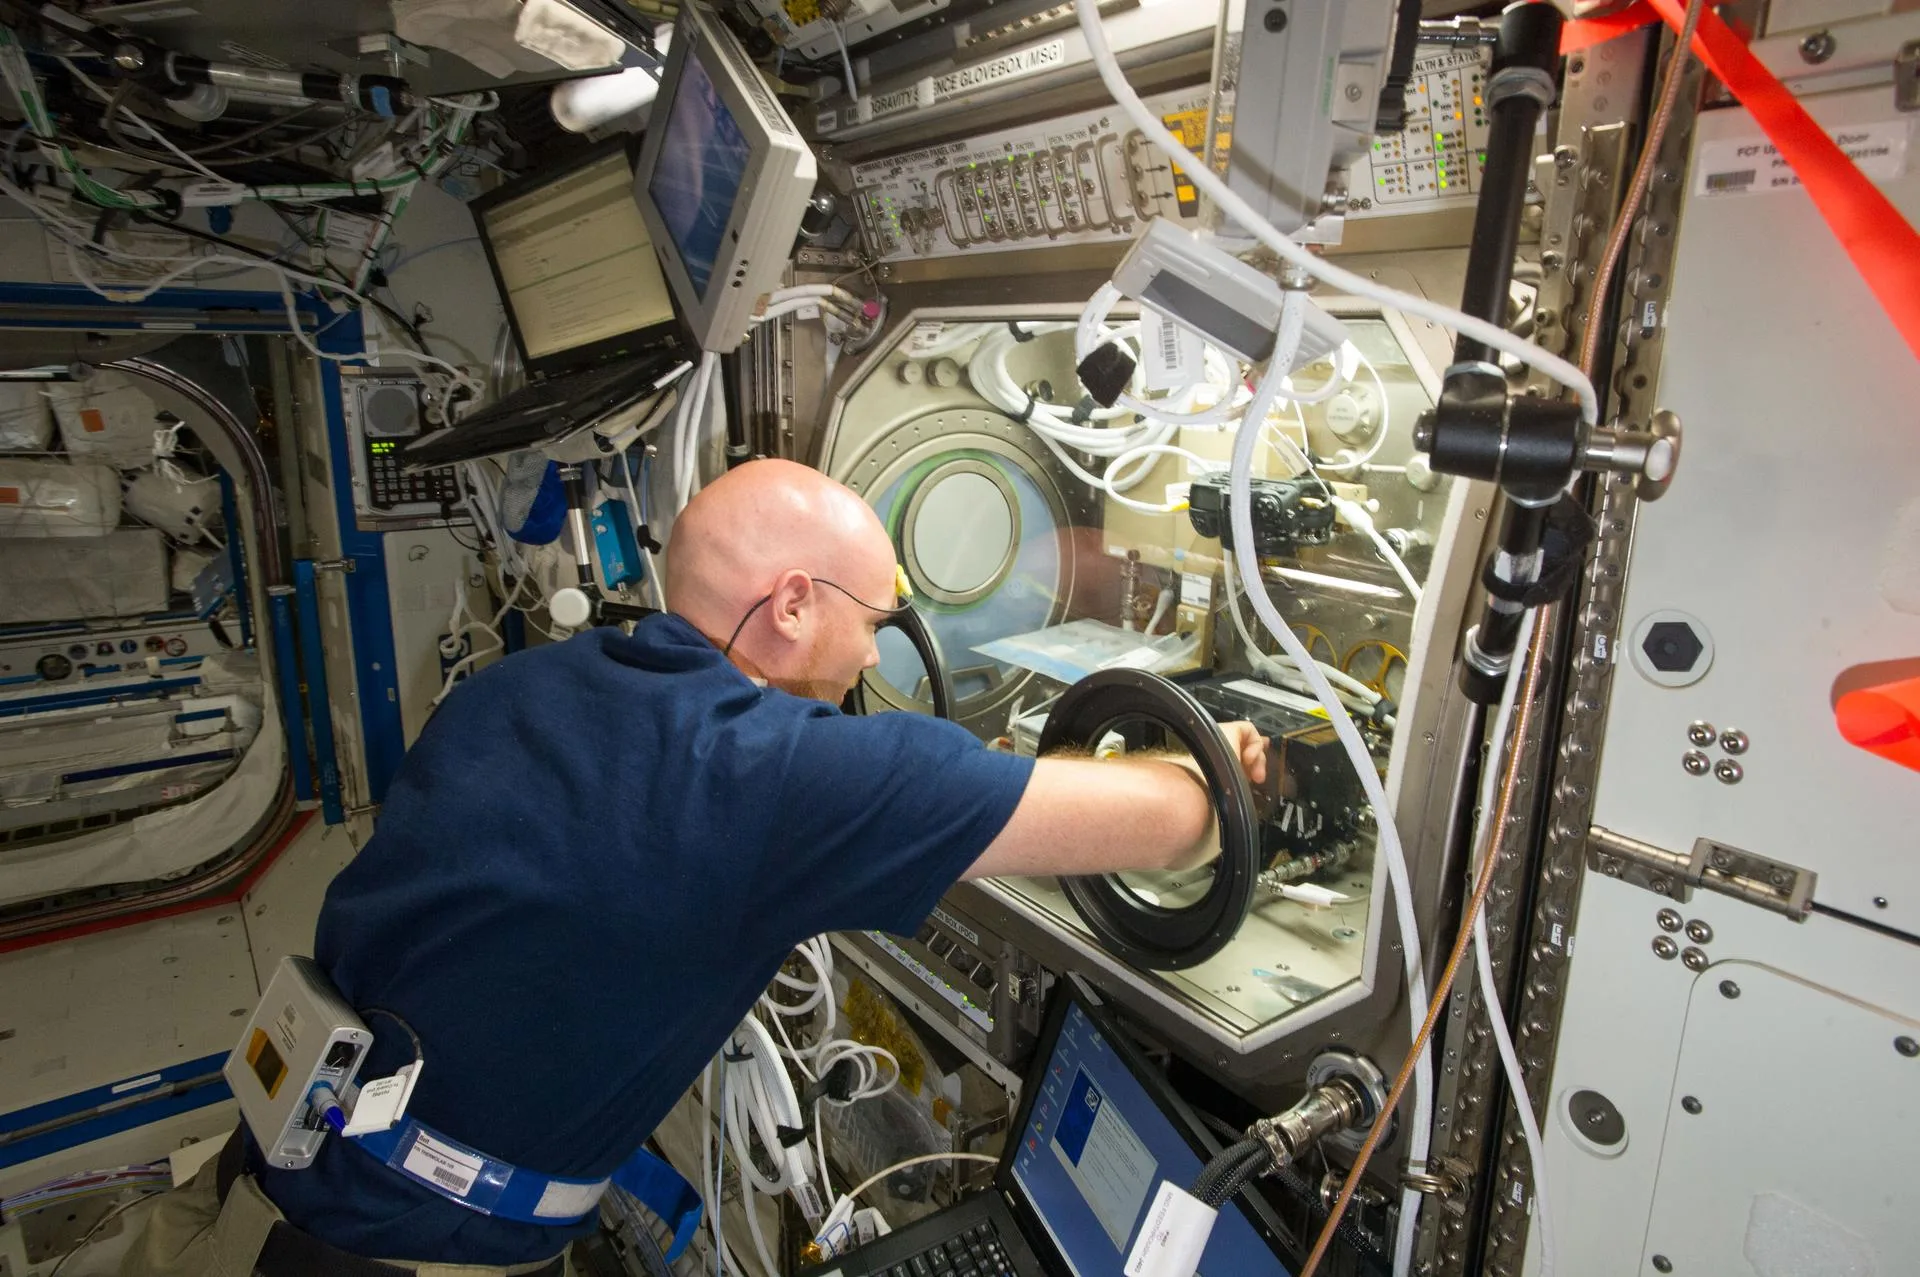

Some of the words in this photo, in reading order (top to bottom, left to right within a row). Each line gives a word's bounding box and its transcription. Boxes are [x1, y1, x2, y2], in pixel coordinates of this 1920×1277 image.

[1438, 58, 1444, 67] &
[1446, 50, 1482, 66] STATUS
[847, 90, 914, 124] MIOGRAVITY
[960, 57, 1023, 88] GLOVEBOX
[1025, 43, 1064, 69] (MSG)
[1837, 133, 1870, 145] Door
[1737, 146, 1760, 157] FCF
[856, 160, 882, 174] COMMAND
[882, 157, 894, 168] AND
[894, 150, 930, 166] MONITORING
[930, 146, 949, 158] PANEL
[420, 1135, 430, 1145] Belt
